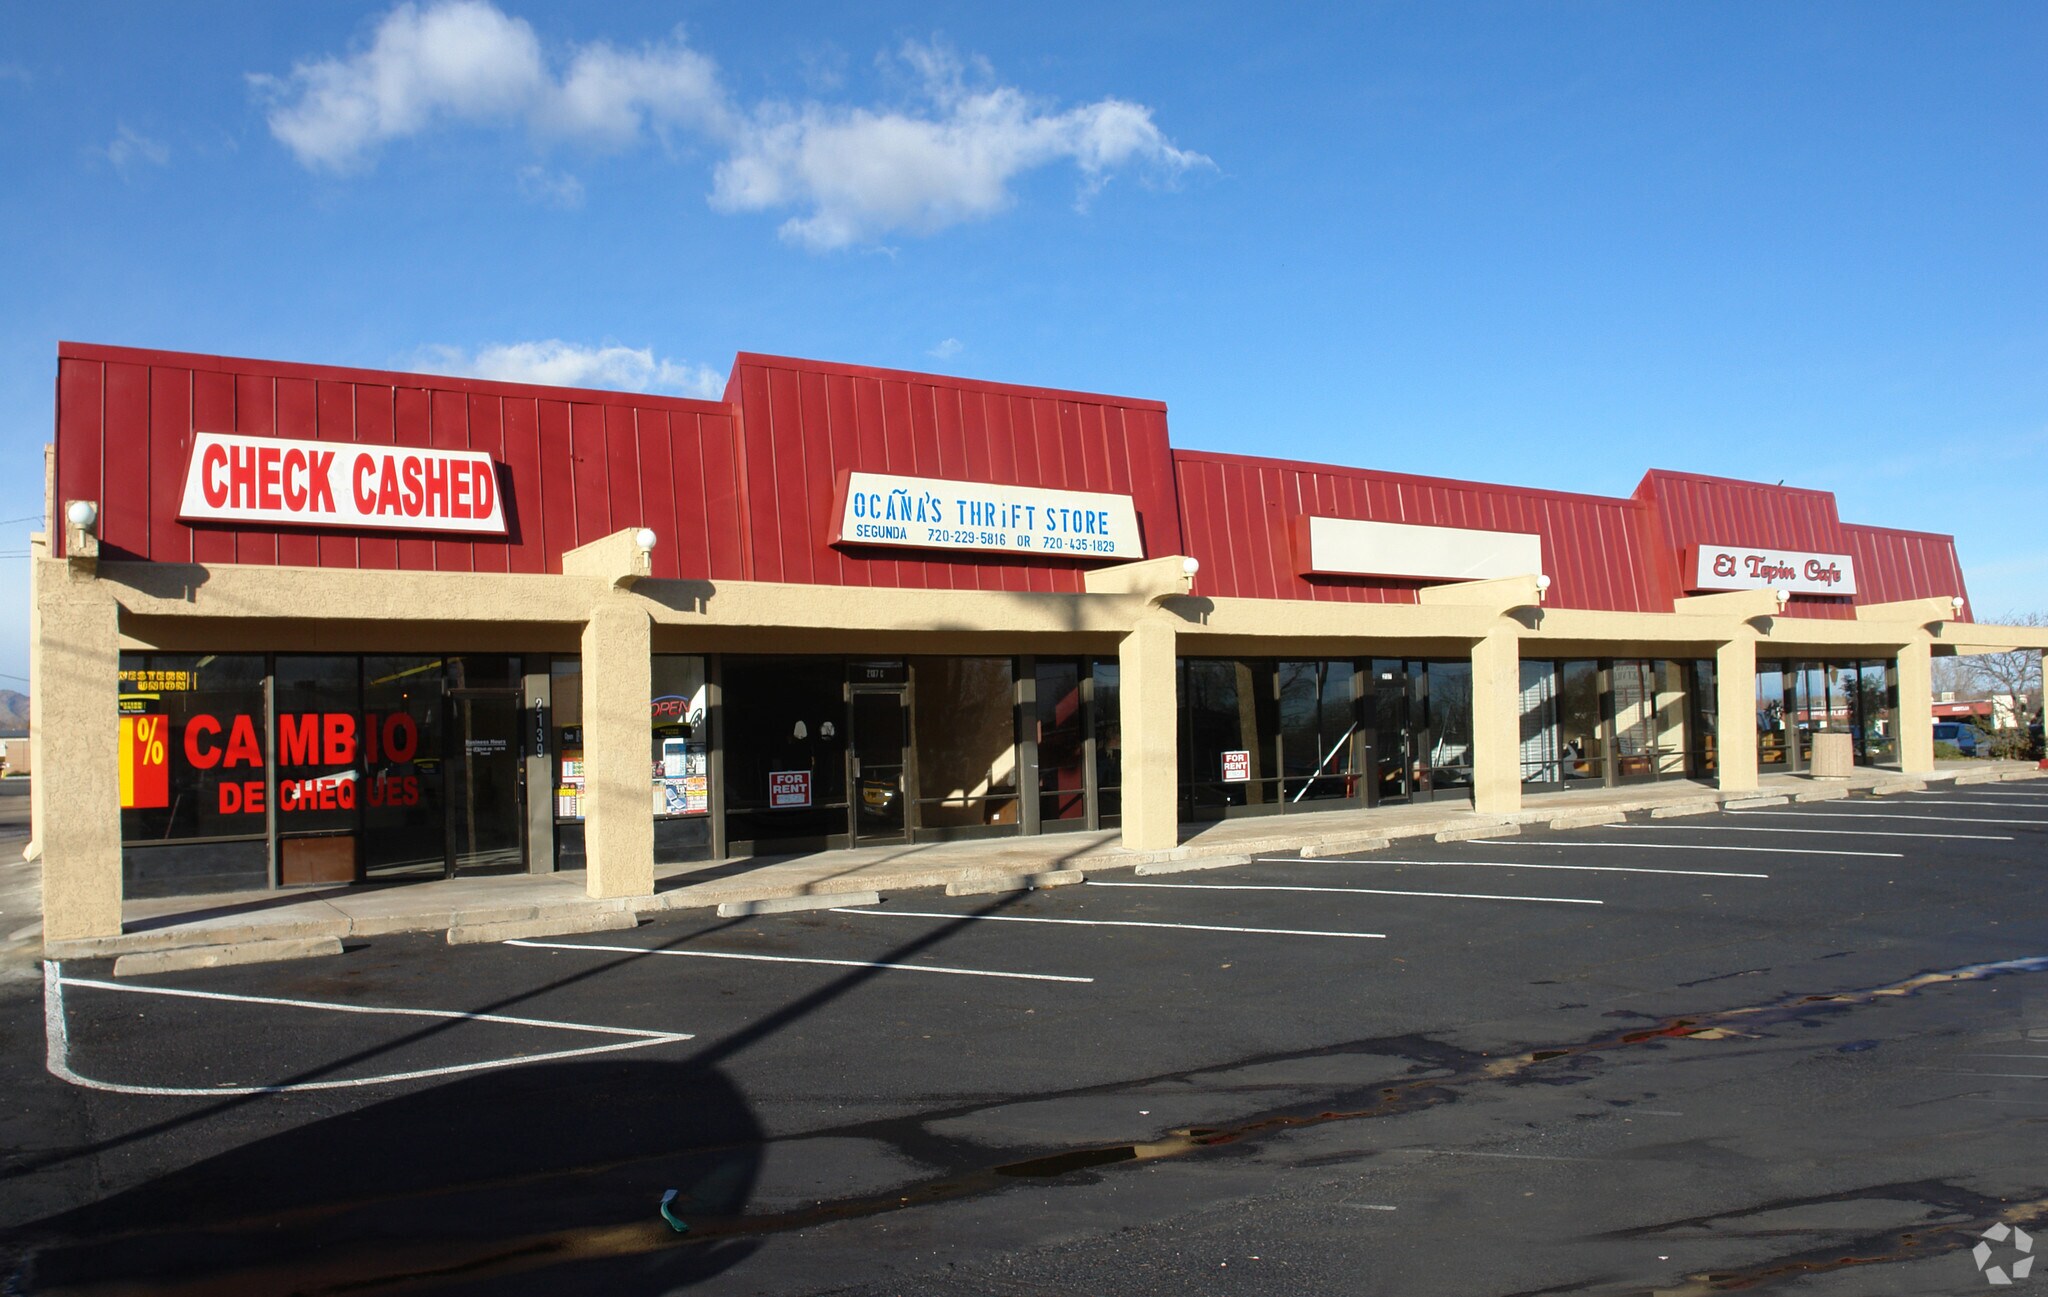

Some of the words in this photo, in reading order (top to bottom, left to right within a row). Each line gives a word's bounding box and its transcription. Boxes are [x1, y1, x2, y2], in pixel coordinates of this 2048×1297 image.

[202, 443, 336, 513] CHECK
[352, 452, 495, 520] CASHED
[1046, 507, 1109, 536] STORE
[856, 524, 907, 540] SEGUNDA
[927, 528, 1007, 546] 720-229-5816
[1017, 534, 1031, 548] OR
[1043, 536, 1116, 553] 720-435-1829
[1713, 553, 1738, 577] El
[1745, 555, 1797, 584] Tepin
[1804, 559, 1842, 587] Cafe
[137, 681, 187, 691] UNION
[651, 700, 691, 716] OPEN
[183, 712, 418, 769] CAMBIO
[533, 697, 544, 758] 2139
[1224, 761, 1248, 770] RENT
[1226, 754, 1245, 762] FOR
[773, 783, 807, 794] RENT
[776, 774, 803, 784] FOR
[218, 781, 266, 815] DE
[279, 776, 419, 813] CHEQUES
